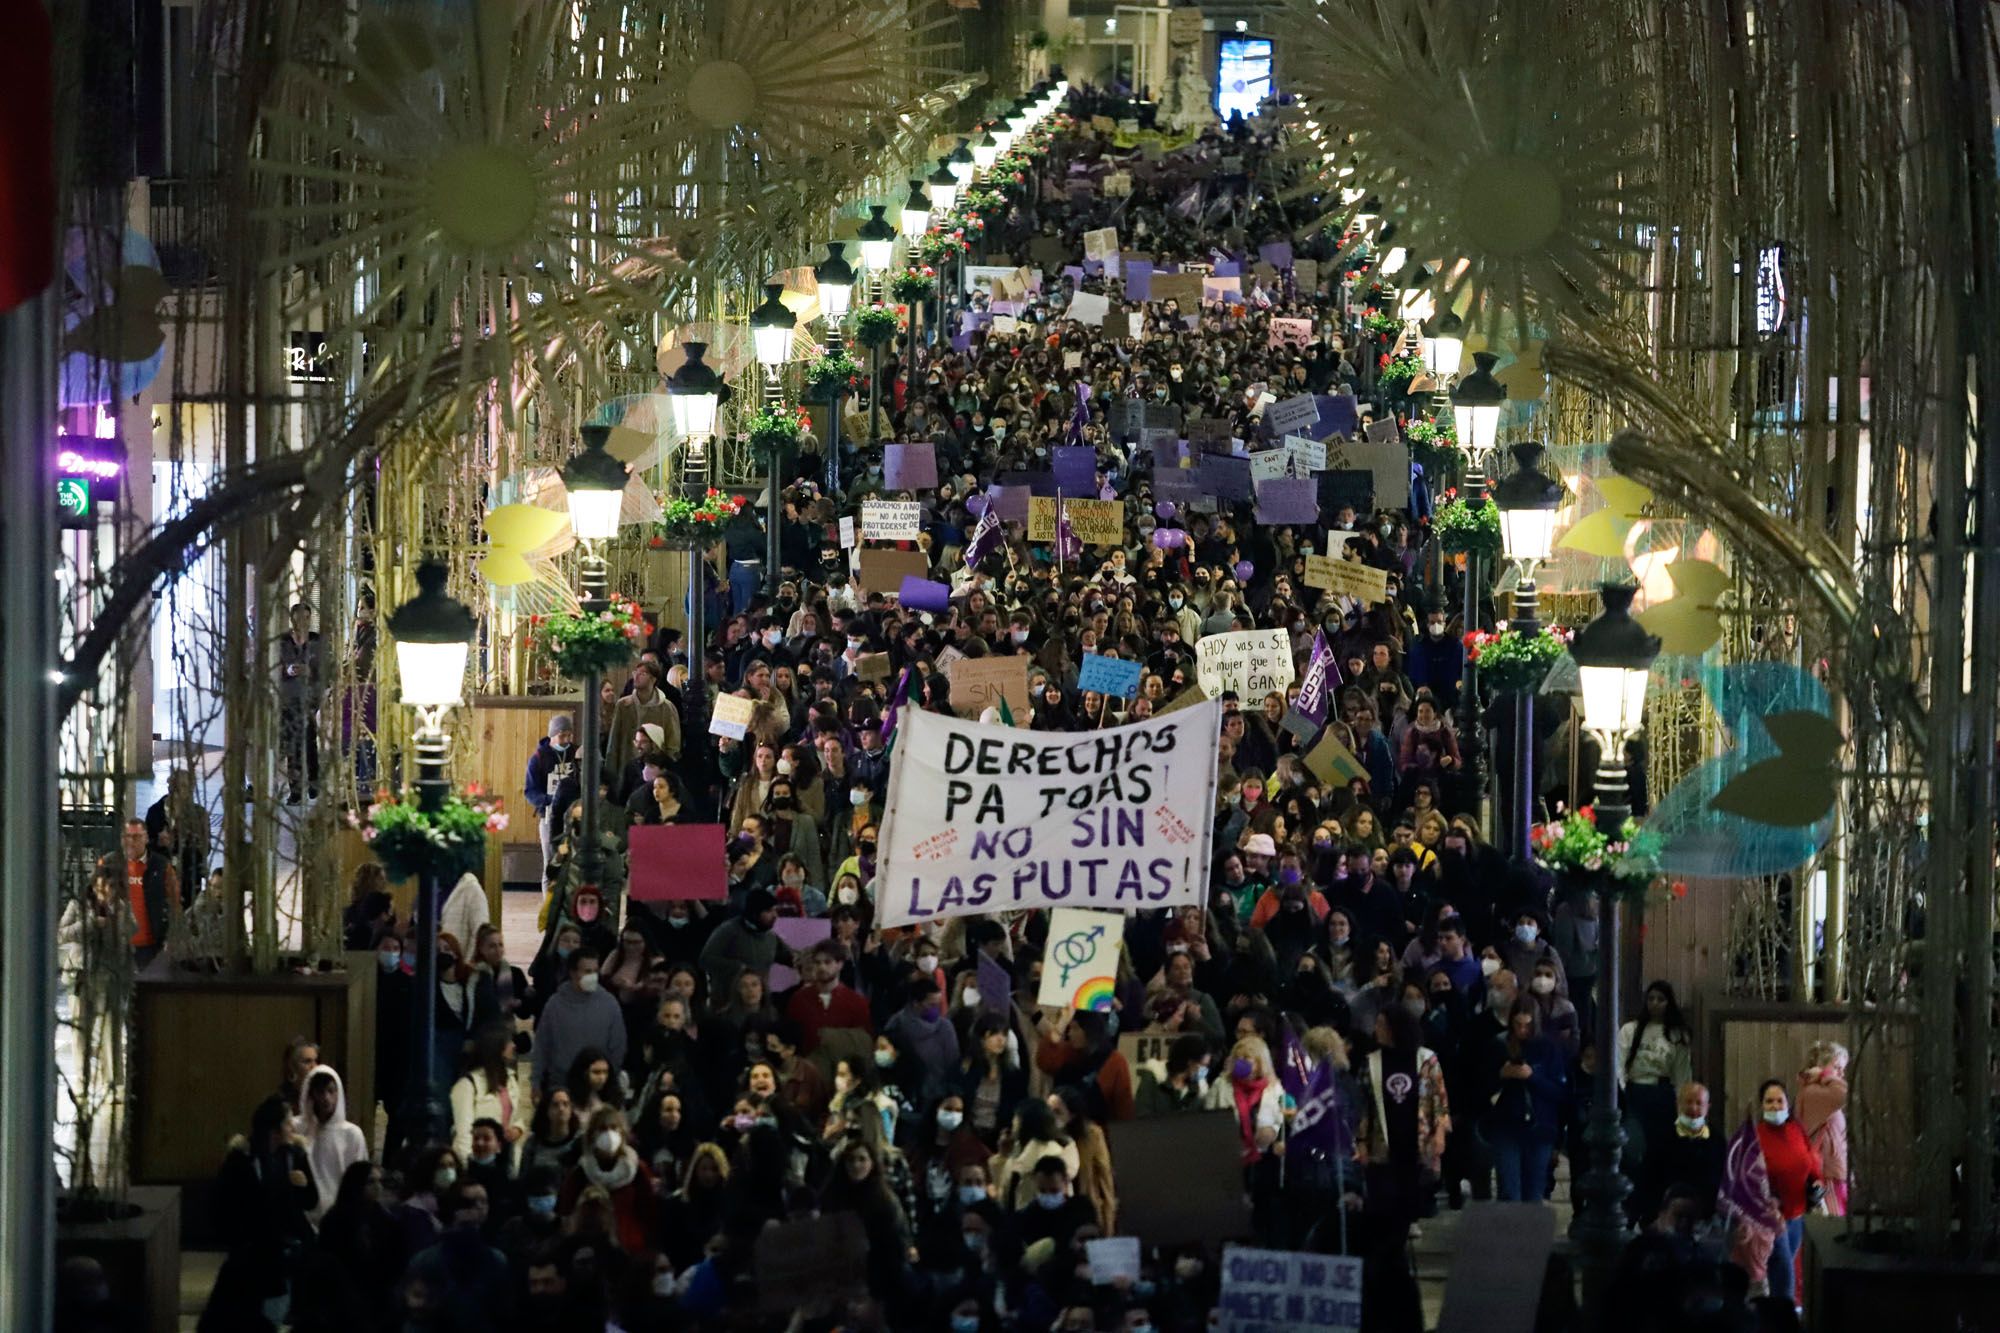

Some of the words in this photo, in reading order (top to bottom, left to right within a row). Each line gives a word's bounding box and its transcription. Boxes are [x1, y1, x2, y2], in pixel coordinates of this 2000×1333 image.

[60, 498, 79, 506] ODY
[880, 512, 889, 520] NO
[893, 512, 898, 520] A
[900, 512, 919, 521] COMO
[1203, 638, 1228, 657] HOY
[1236, 640, 1253, 651] vas
[1259, 640, 1265, 649] a
[1203, 662, 1211, 675] la
[1216, 660, 1243, 677] mujer
[1251, 658, 1268, 673] que
[1278, 655, 1287, 667] te
[970, 681, 1004, 704] SIN
[1210, 684, 1219, 696] de
[1247, 675, 1284, 690] GANA
[945, 724, 1178, 775] DERECHOS
[945, 780, 1005, 824] PA
[970, 827, 1032, 861] NO
[1071, 806, 1145, 849] SIN
[908, 873, 997, 916] LAS
